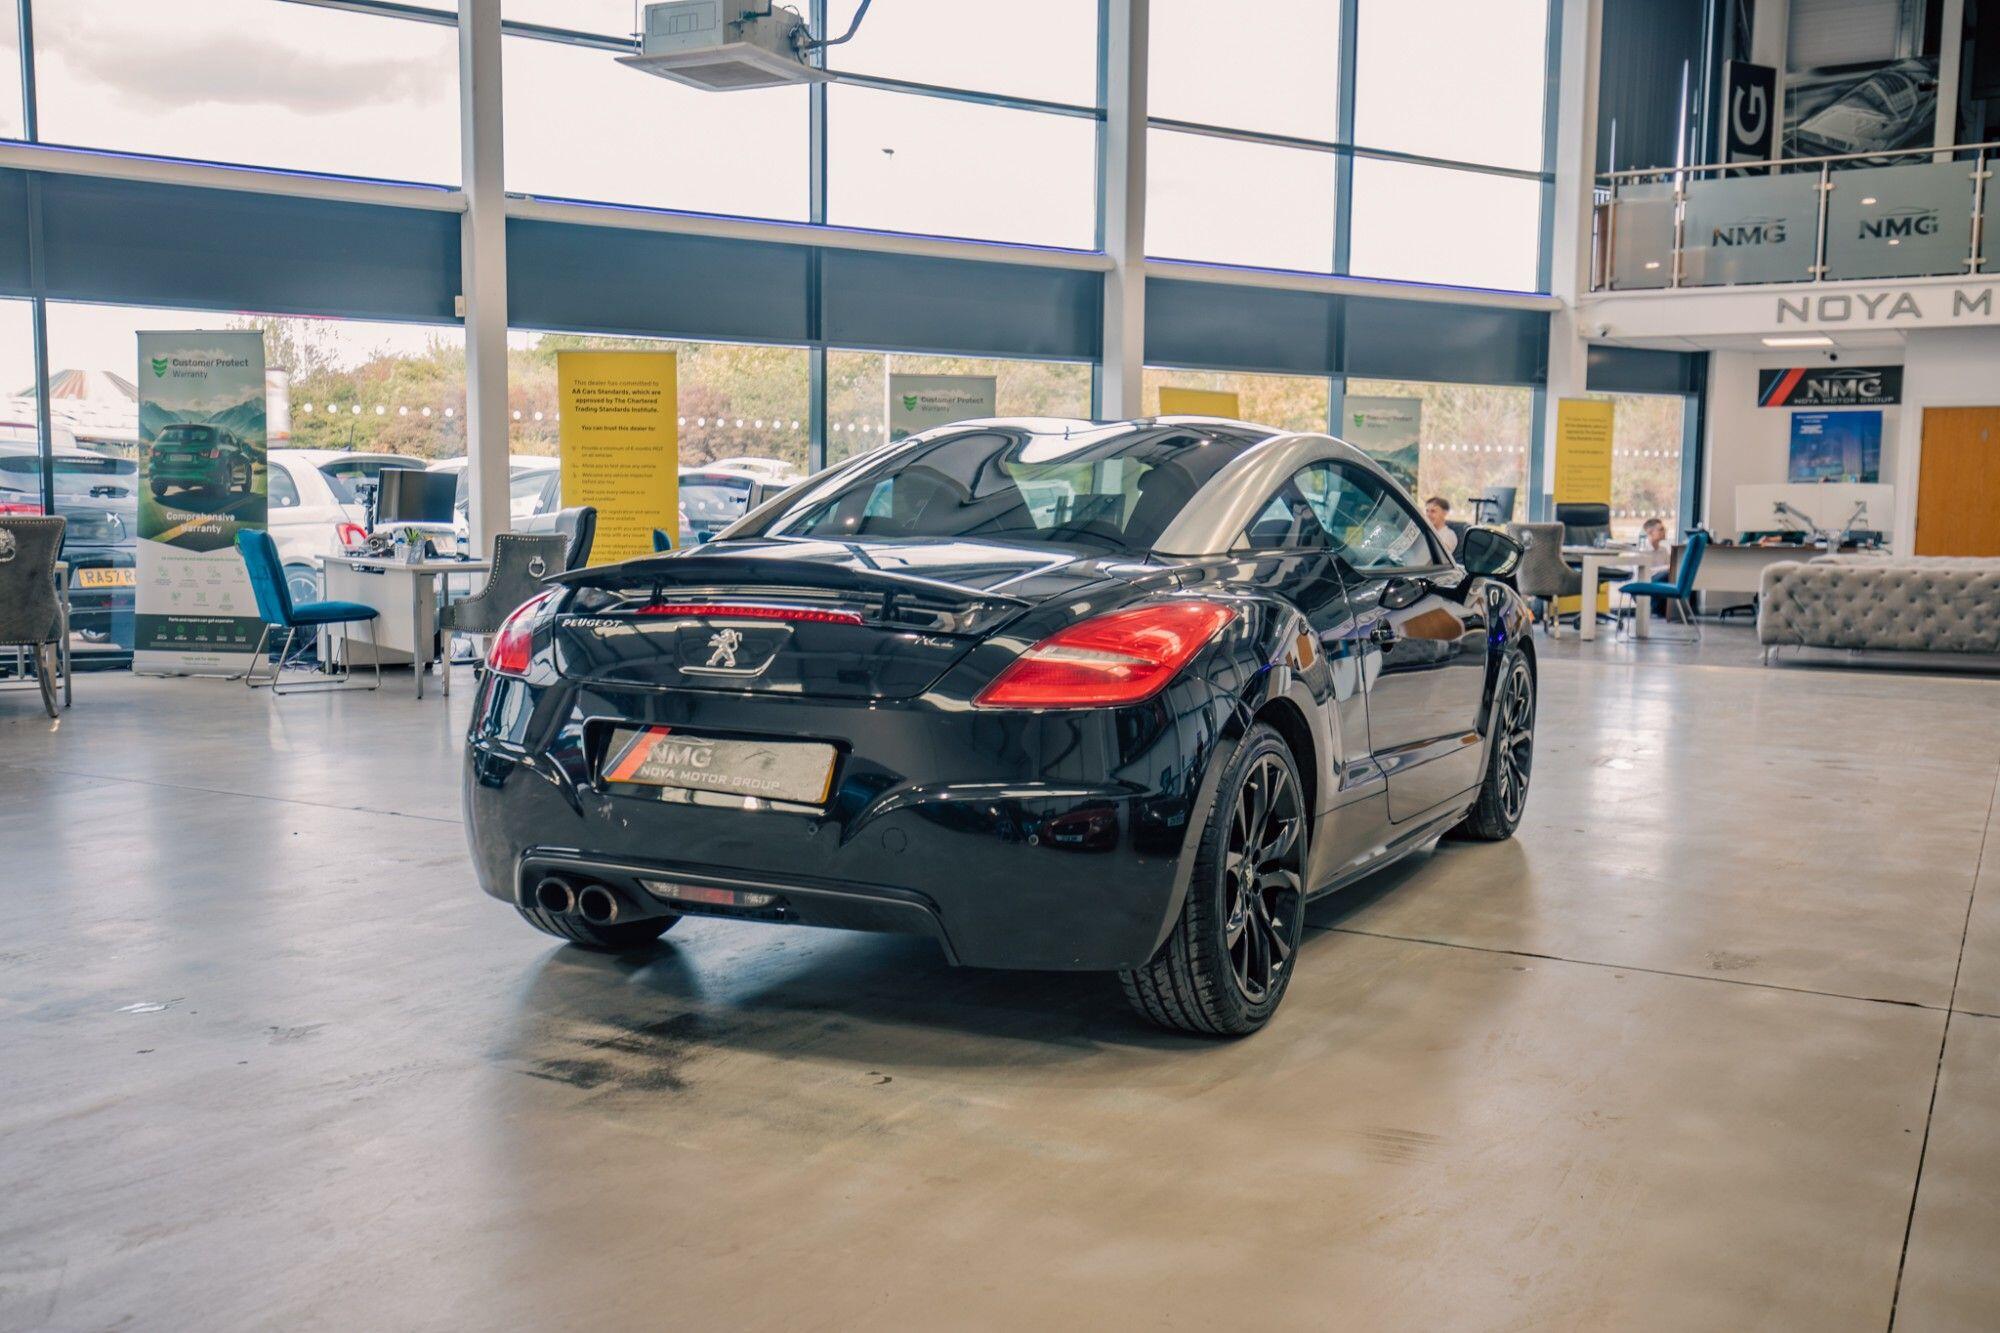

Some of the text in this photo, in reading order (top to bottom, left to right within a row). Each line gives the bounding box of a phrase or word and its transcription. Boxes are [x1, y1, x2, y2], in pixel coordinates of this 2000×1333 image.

[1712, 225, 1786, 247] NMG
[1858, 215, 1939, 239] NMG
[1776, 288, 1992, 323] NOYA M
[172, 358, 249, 368] Customer Protect
[172, 370, 208, 379] Warranty
[1807, 378, 1882, 398] NMG
[166, 511, 236, 522] Comprehensive
[86, 570, 136, 584] RA57 R
[562, 618, 623, 628] PEUGEOT
[647, 744, 712, 768] NMG
[640, 767, 780, 790] NOYA MOTOR GROUP
